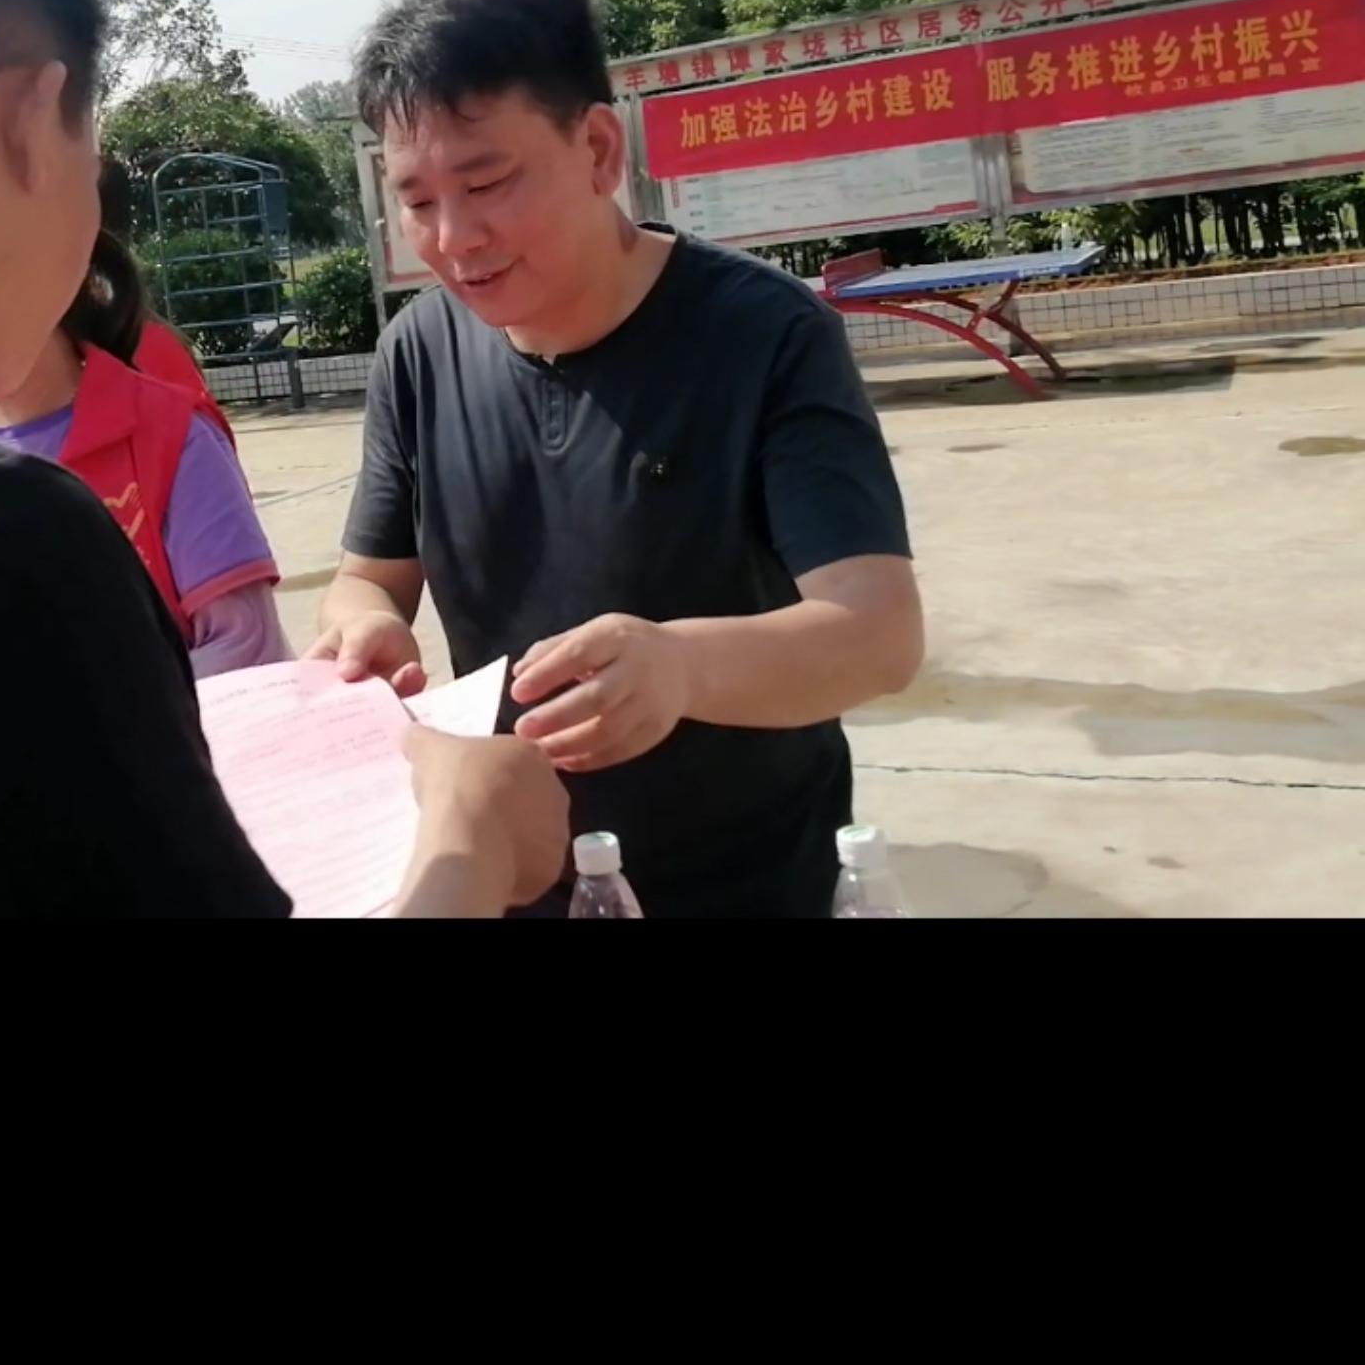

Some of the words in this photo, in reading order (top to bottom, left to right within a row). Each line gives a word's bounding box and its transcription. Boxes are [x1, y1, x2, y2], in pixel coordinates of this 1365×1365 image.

[679, 68, 954, 150] 加强法治乡村建设
[986, 9, 1319, 103] 服务推进乡村振兴
